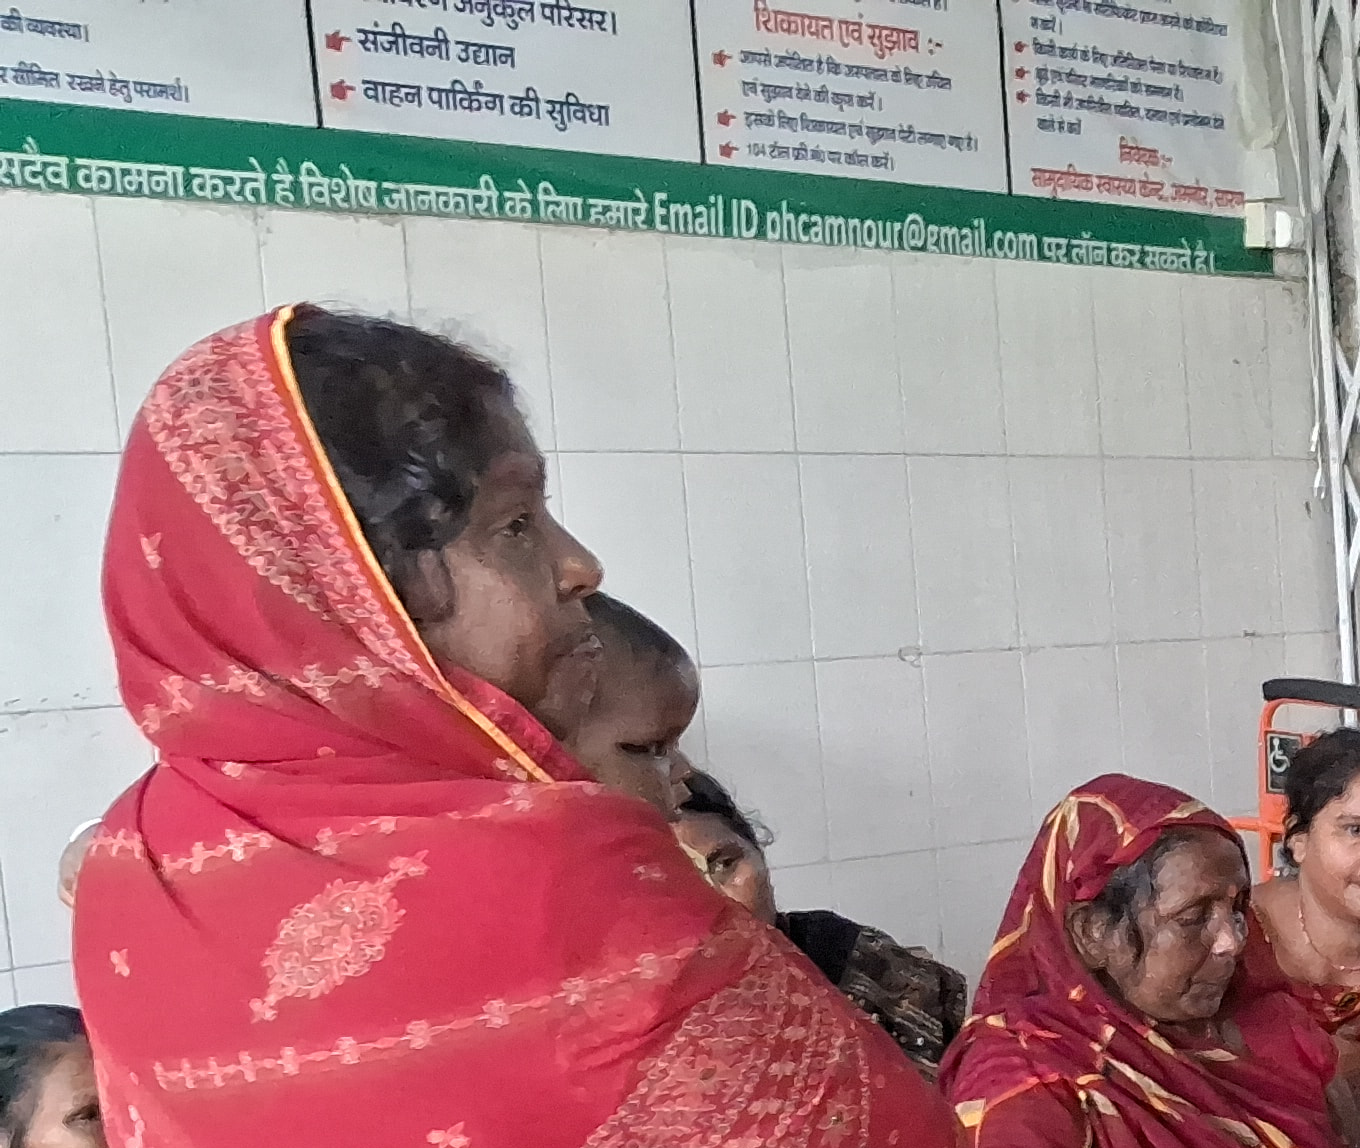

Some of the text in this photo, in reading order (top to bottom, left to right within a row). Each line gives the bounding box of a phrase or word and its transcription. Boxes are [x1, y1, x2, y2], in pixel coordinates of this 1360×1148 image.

[357, 20, 516, 69] संजीवनी उद्यान
[754, 2, 834, 42] शिकायत
[838, 13, 864, 49] एवं
[867, 24, 921, 60] सुझाव
[362, 78, 610, 133] वाहन पार्किंग की सुविधा
[0, 136, 70, 190] सदैव
[74, 157, 185, 198] कामना
[188, 155, 267, 204] करते
[271, 156, 294, 208] है
[300, 158, 378, 210] विशेष
[381, 173, 499, 219] जानकारी
[503, 177, 532, 219] के
[588, 187, 649, 230] हमारे
[653, 191, 724, 236] Email
[730, 198, 758, 238] ID
[1042, 236, 1068, 264] पर
[1110, 243, 1142, 268] कर
[1143, 237, 1191, 272] सकते
